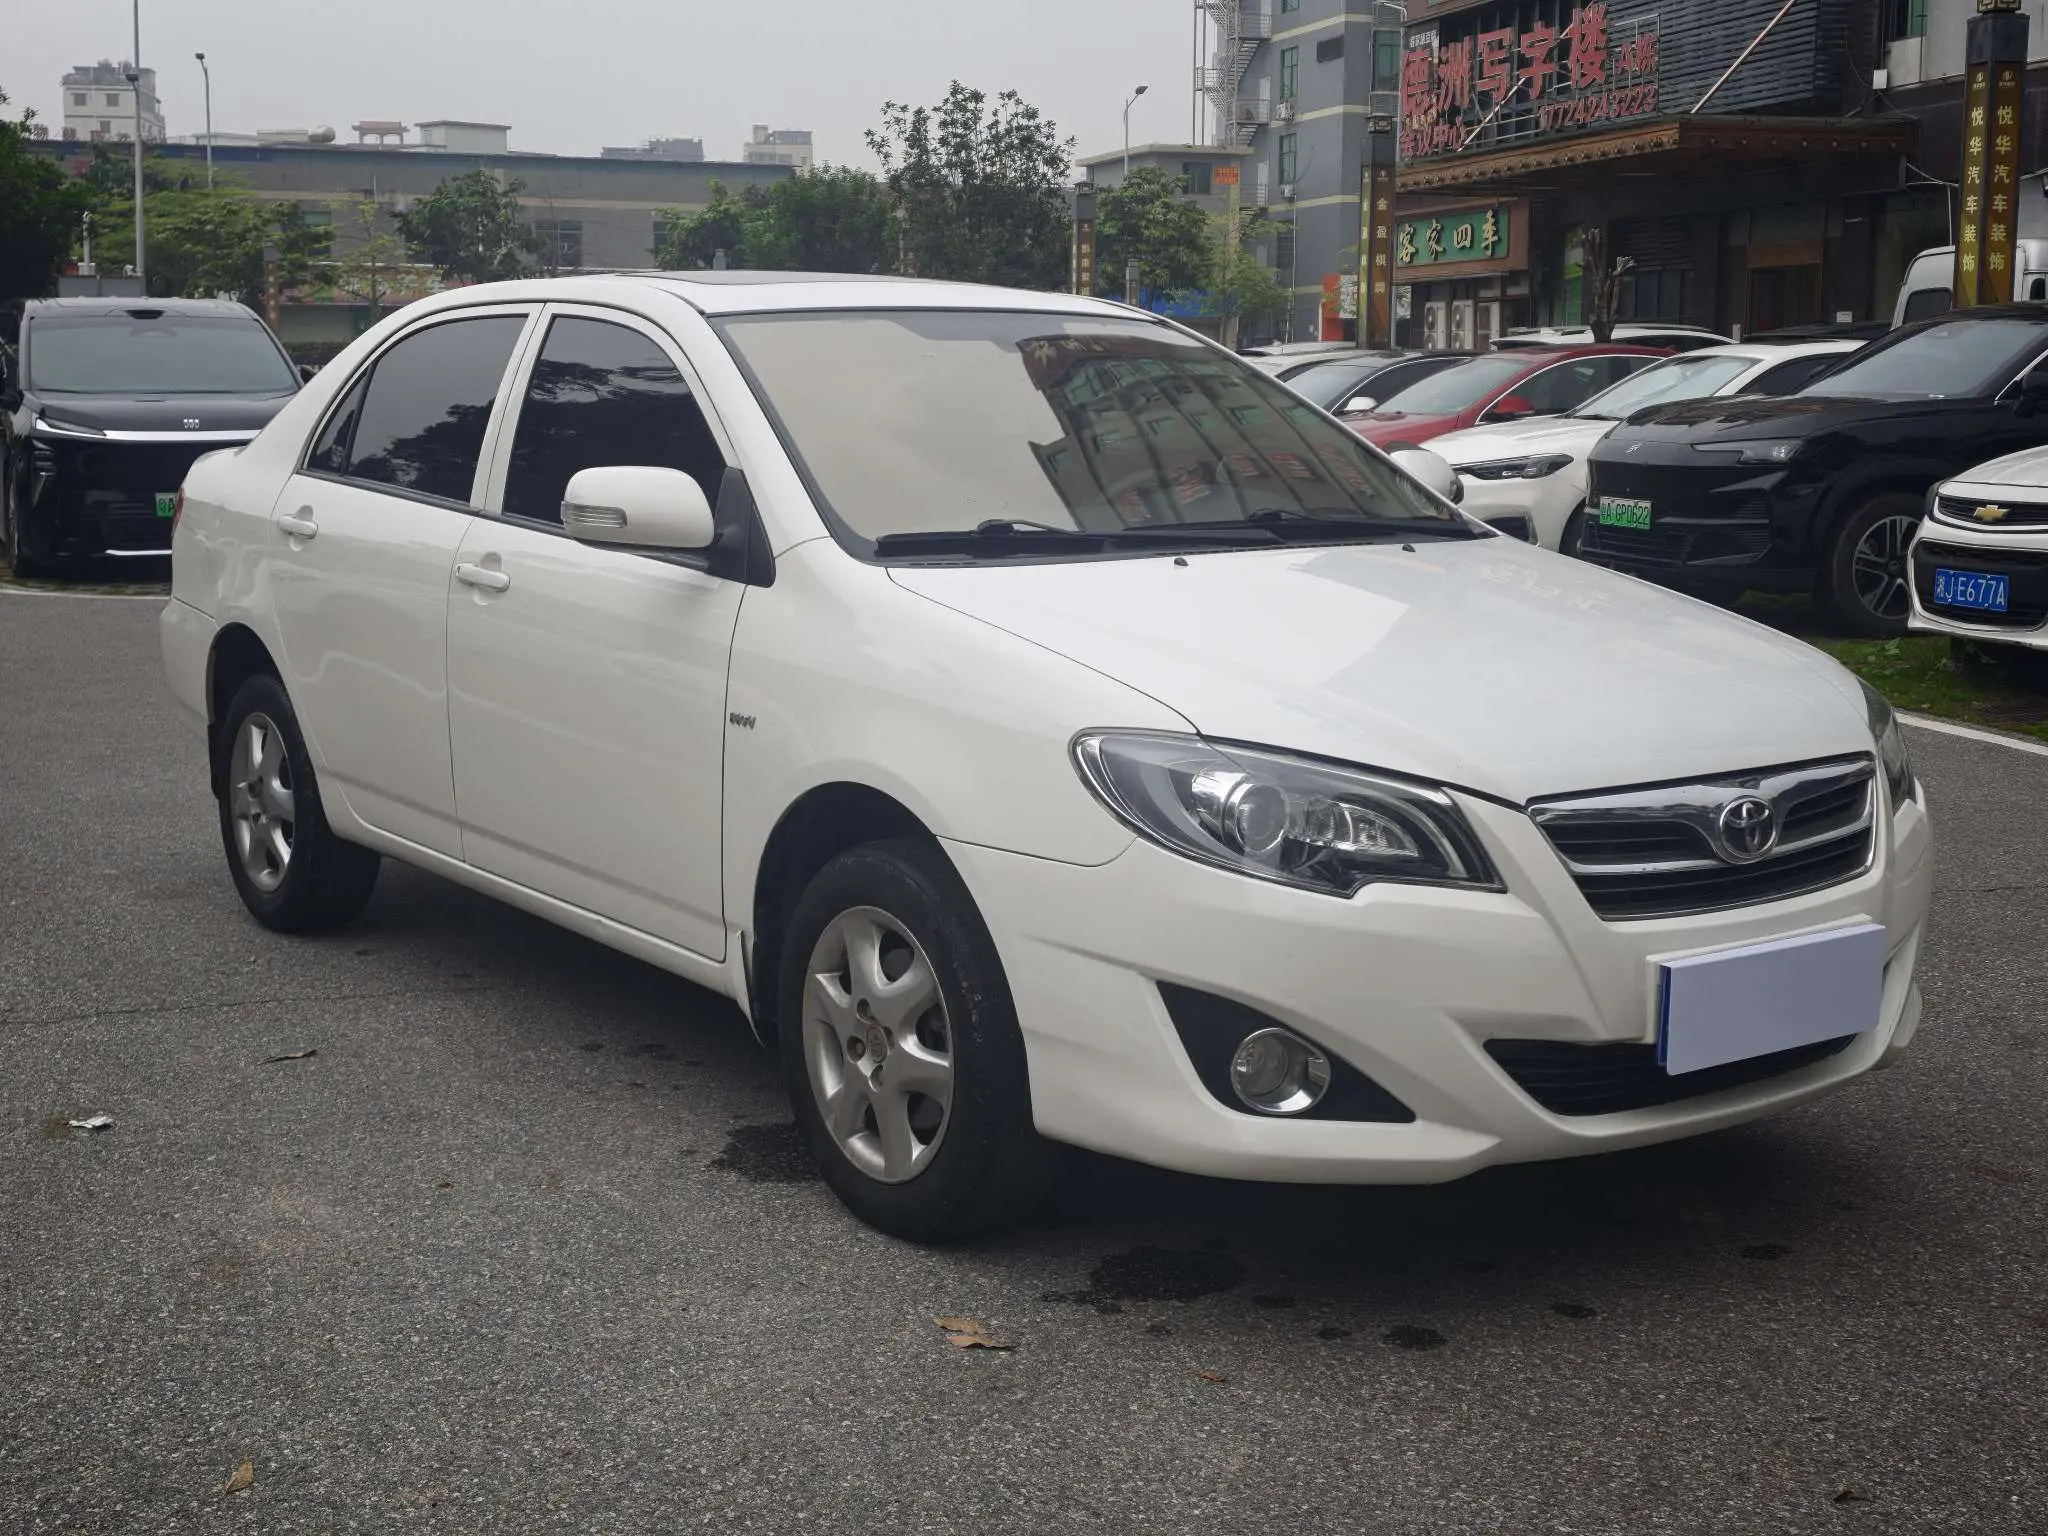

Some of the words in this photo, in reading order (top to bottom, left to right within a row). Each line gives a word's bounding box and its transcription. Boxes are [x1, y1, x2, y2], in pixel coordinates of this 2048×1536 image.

[1961, 105, 1985, 272] 悦华汽车装饰
[1988, 105, 2014, 272] 悦华汽车装饰
